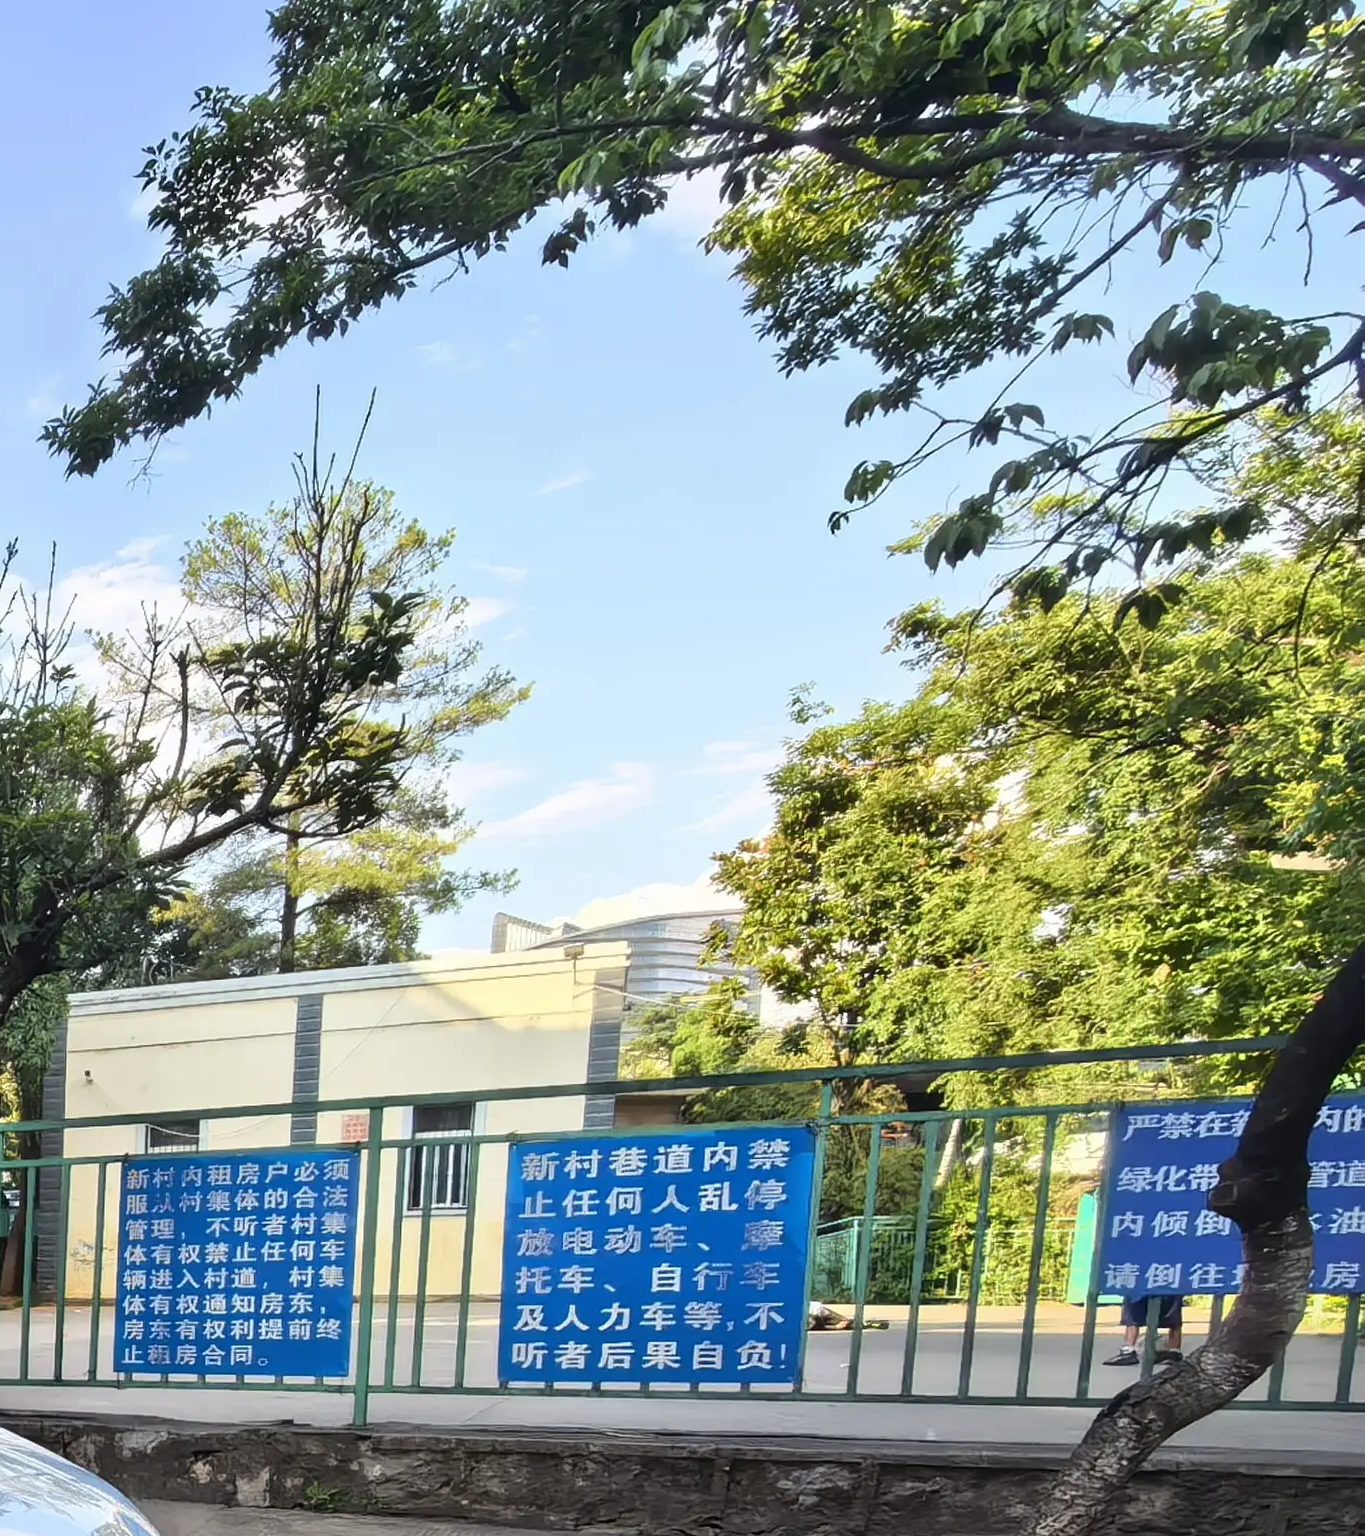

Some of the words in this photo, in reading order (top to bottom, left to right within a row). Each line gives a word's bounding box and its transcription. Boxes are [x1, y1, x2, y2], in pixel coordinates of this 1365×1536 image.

[126, 1158, 350, 1190] 新村内租房户必须
[520, 1137, 791, 1181] 新村巷道内禁
[125, 1185, 349, 1215] 服从村集体的合法
[518, 1179, 788, 1219] 止任何人乱停
[123, 1239, 346, 1266] 体有权禁止任何车
[122, 1318, 342, 1341] 房东有权利提前终
